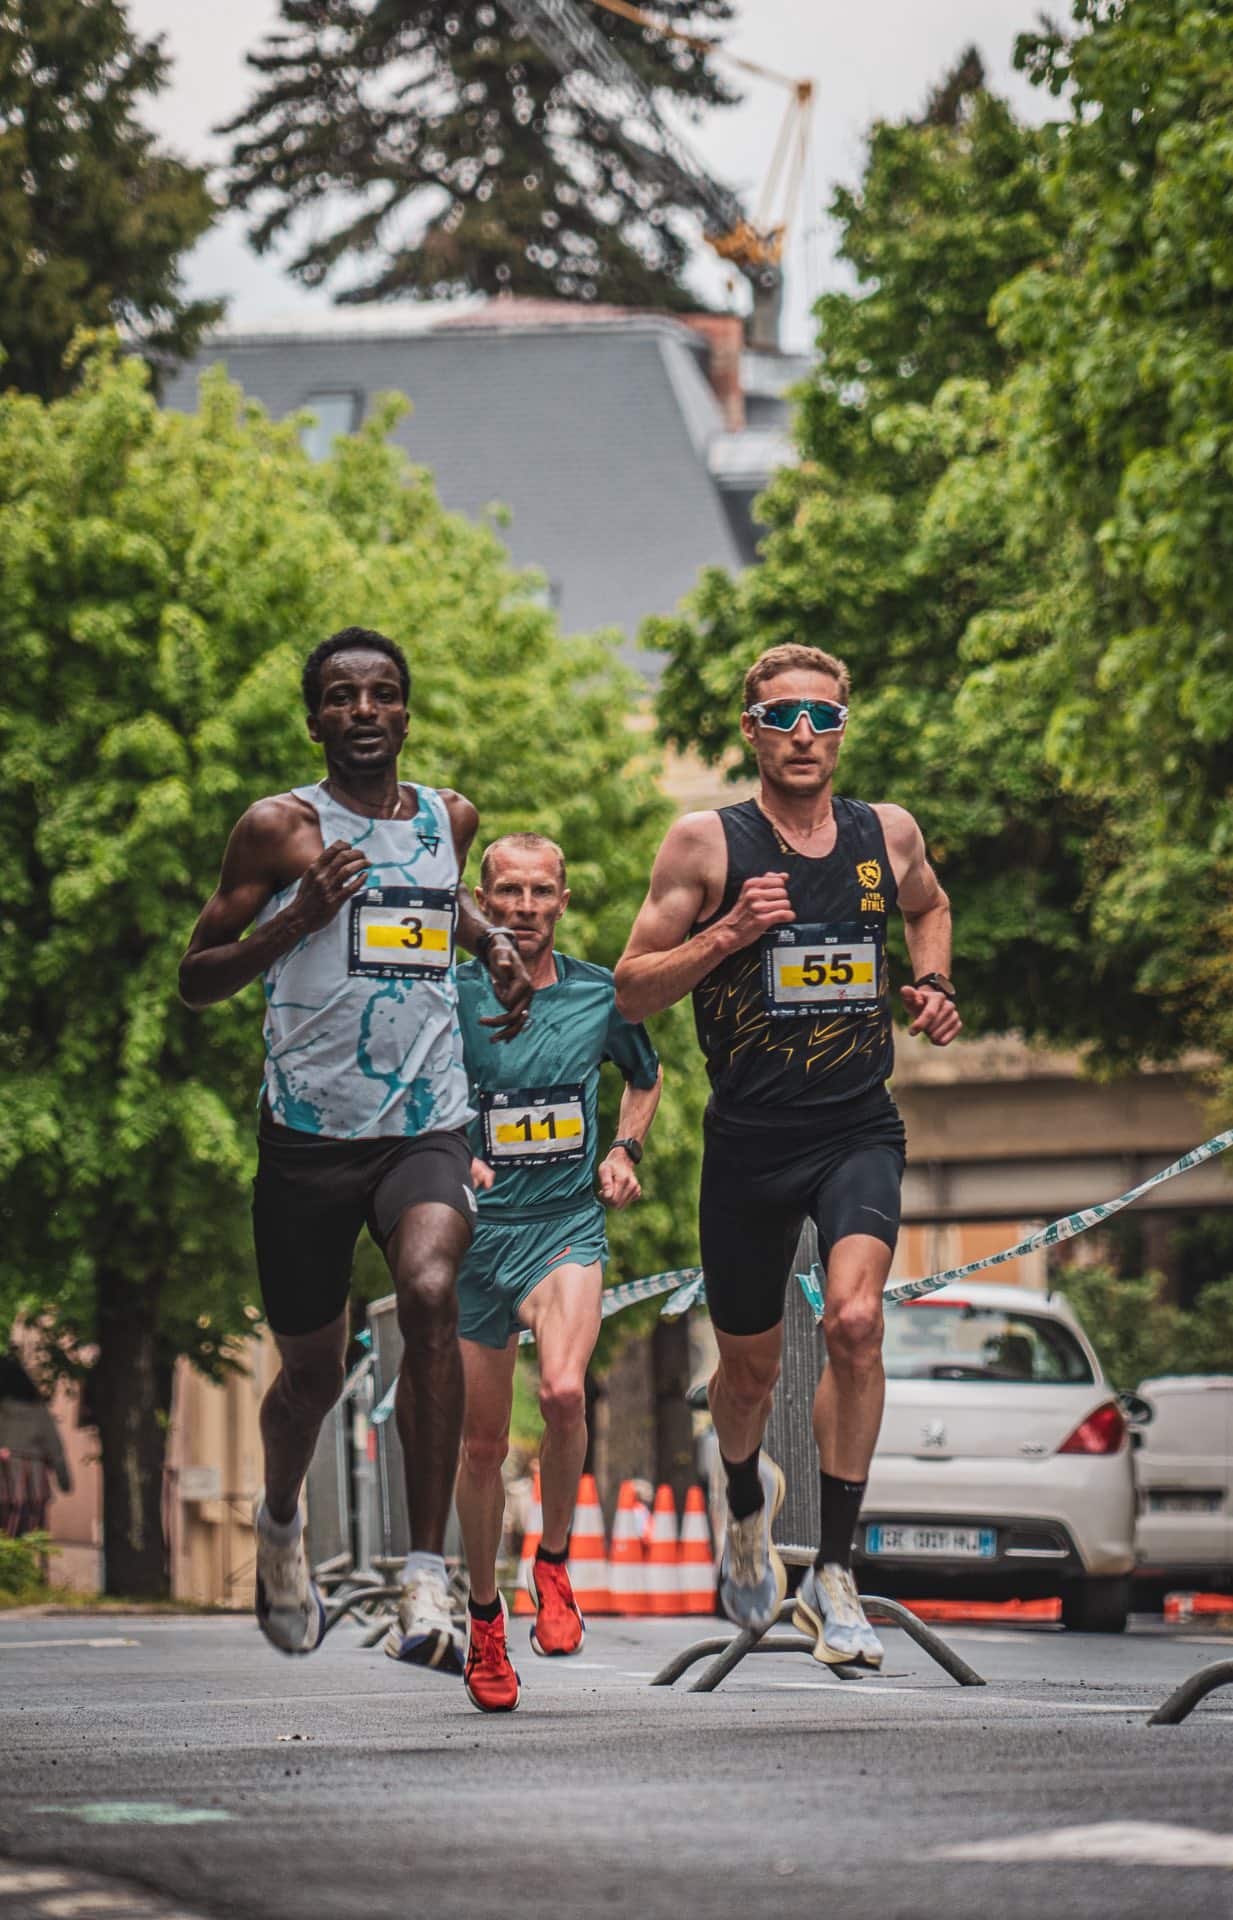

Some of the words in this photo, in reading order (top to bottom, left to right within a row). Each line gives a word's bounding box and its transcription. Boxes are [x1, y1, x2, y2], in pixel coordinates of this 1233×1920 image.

[400, 917, 423, 949] 3
[801, 953, 854, 986] 55
[516, 1111, 557, 1141] 11
